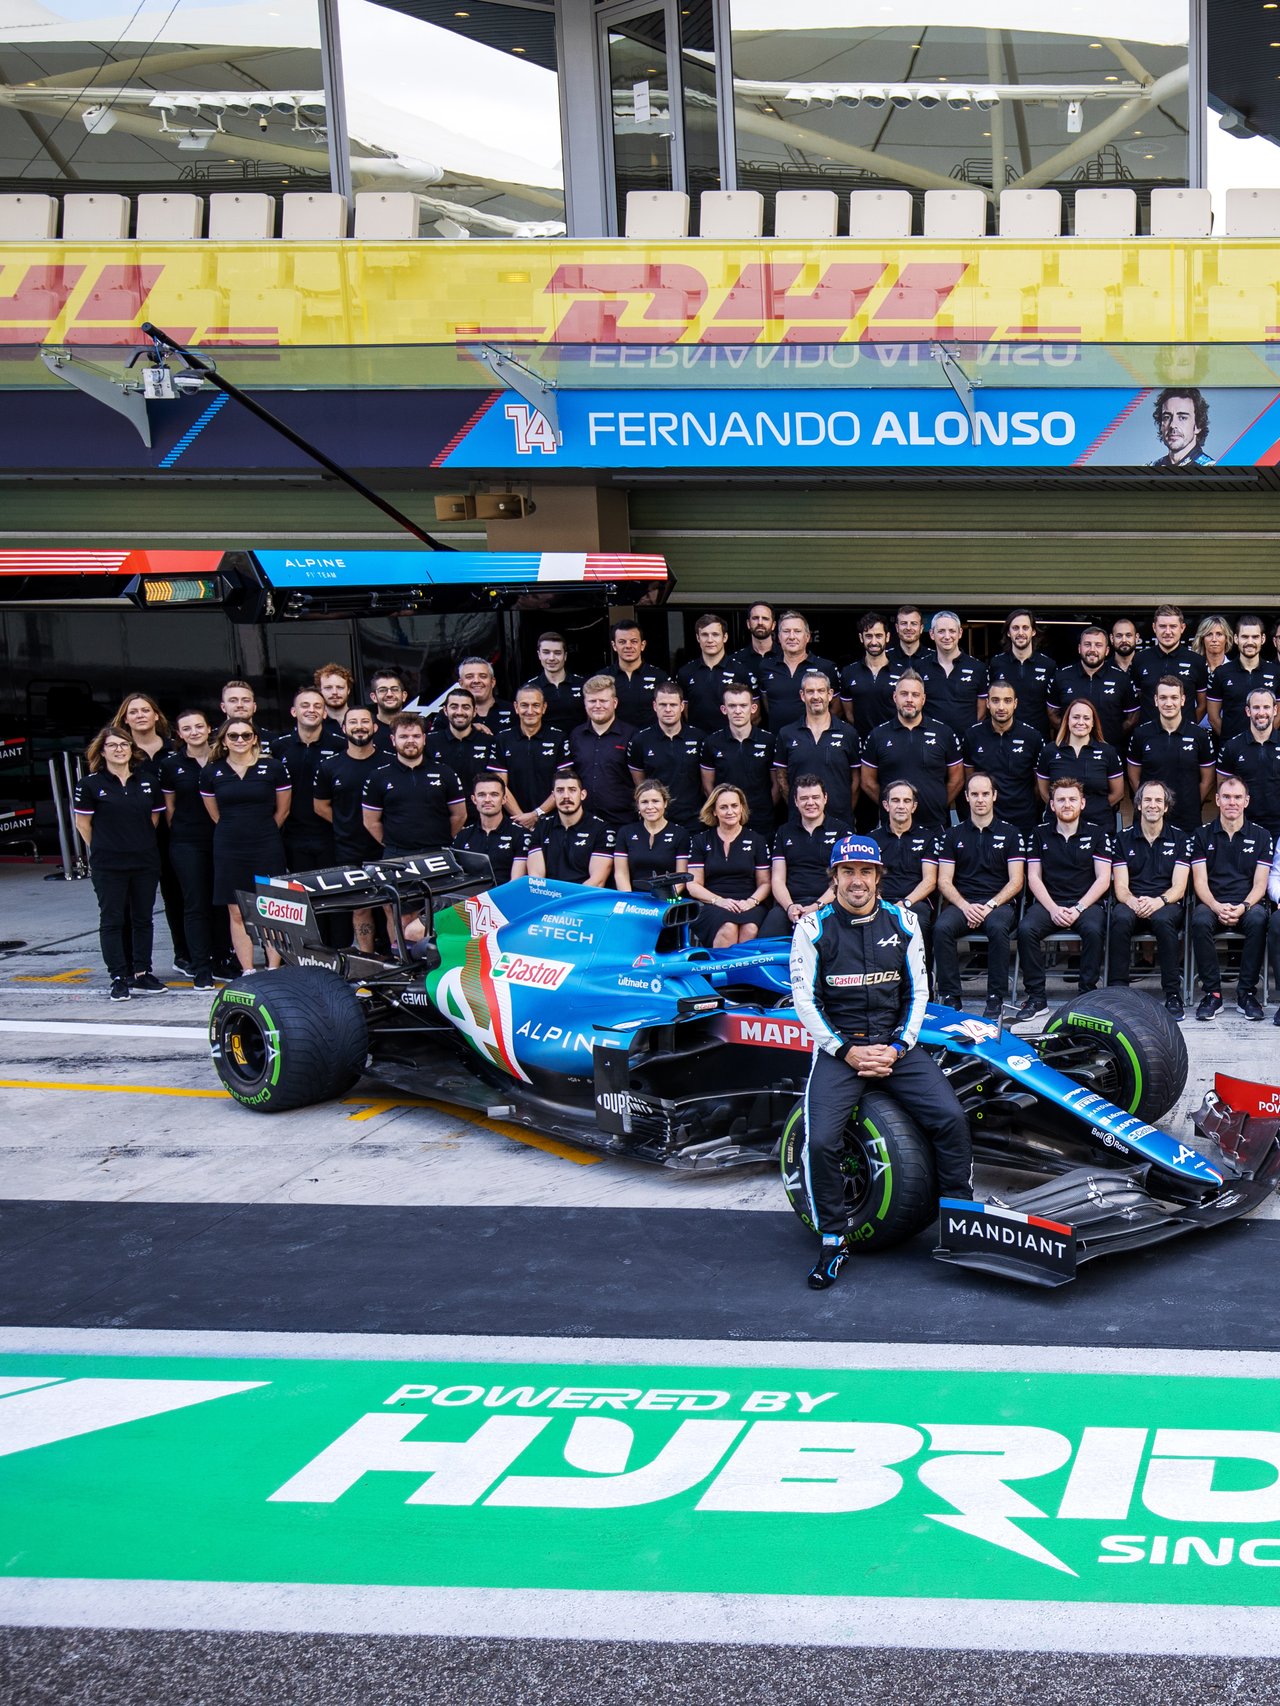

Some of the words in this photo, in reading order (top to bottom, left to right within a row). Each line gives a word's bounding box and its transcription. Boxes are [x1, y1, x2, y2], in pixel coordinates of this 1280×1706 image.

[540, 263, 998, 361] DHL
[505, 404, 562, 454] 14
[588, 411, 860, 446] FERNANDO
[871, 411, 1076, 446] ALONSO
[285, 558, 347, 568] ALPINE
[0, 747, 23, 759] IANT
[0, 818, 33, 832] NDIANT
[841, 843, 874, 855] kimoa
[528, 877, 546, 888] Delphi
[529, 886, 562, 899] Technologies
[267, 900, 305, 922] Castrol
[465, 899, 496, 938] 14
[625, 904, 660, 917] Microsoft
[541, 914, 584, 927] RENAULT
[528, 924, 594, 945] E-TECH
[506, 958, 566, 987] Castrol
[691, 956, 775, 972] ALPINECARS.COM
[618, 976, 649, 989] ultimate
[834, 975, 862, 986] Castrol
[223, 989, 256, 1007] PIRELLI
[1067, 1012, 1114, 1035] PIRELLI
[740, 1020, 814, 1048] MAPF
[1091, 1127, 1105, 1140] Bell
[1113, 1141, 1130, 1155] Ross
[949, 1218, 1067, 1259] MANDIANT
[384, 1384, 730, 1411] POWERED
[740, 1391, 838, 1413] BY
